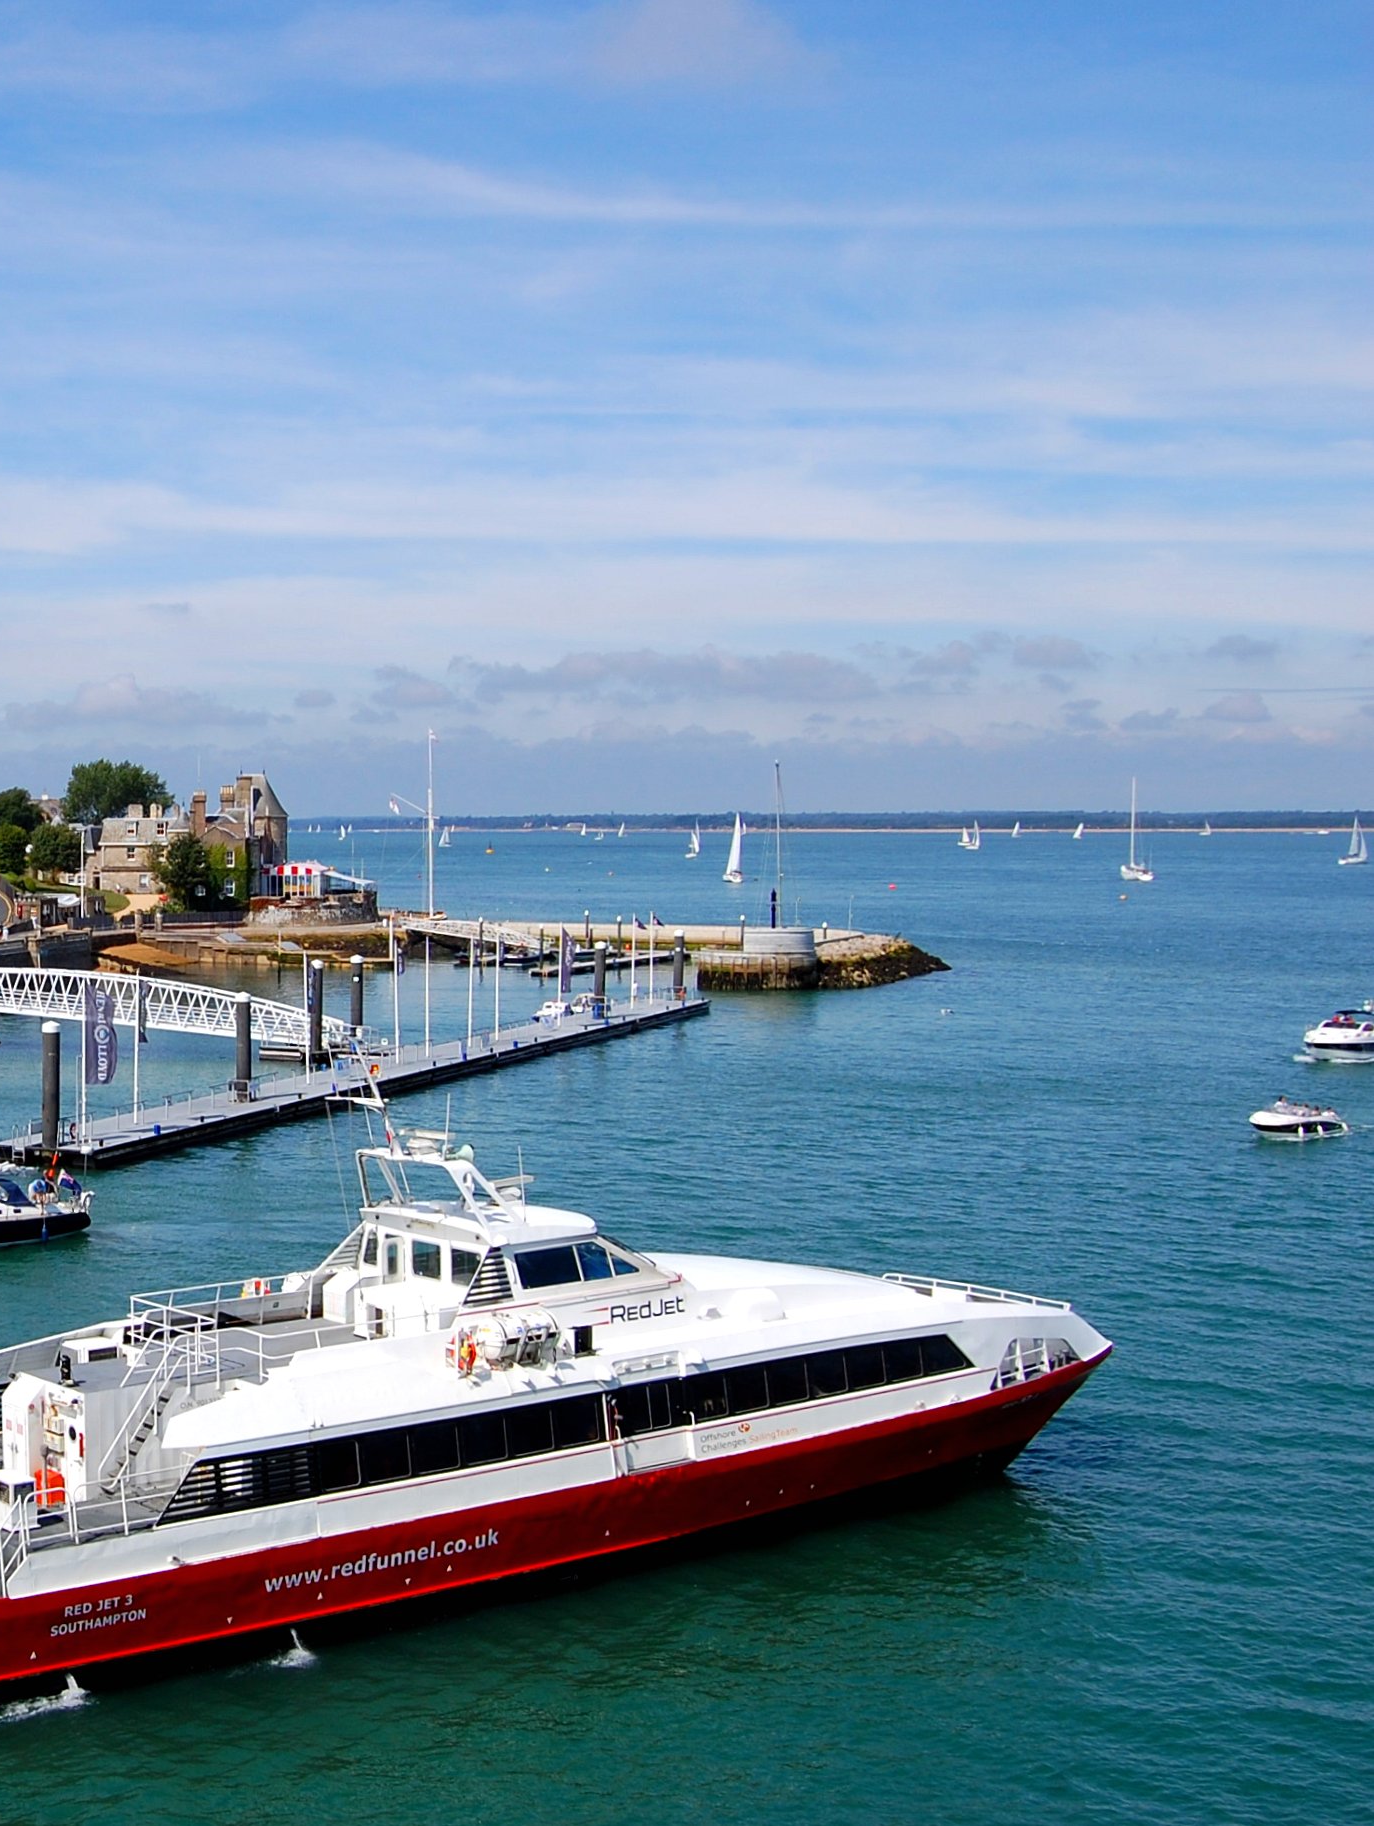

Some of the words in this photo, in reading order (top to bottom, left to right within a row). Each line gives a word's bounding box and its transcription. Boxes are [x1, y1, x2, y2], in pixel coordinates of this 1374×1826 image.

[96, 990, 106, 1024] HENRI
[97, 1045, 108, 1081] LLOYD
[700, 1430, 736, 1443] Offshore
[701, 1438, 746, 1453] Challenges
[264, 1528, 499, 1593] www.redfunnel.co.uk
[64, 1602, 93, 1617] RED
[96, 1596, 121, 1612] JET
[124, 1594, 133, 1606] 3
[50, 1608, 147, 1637] SOUTHAMPTON
